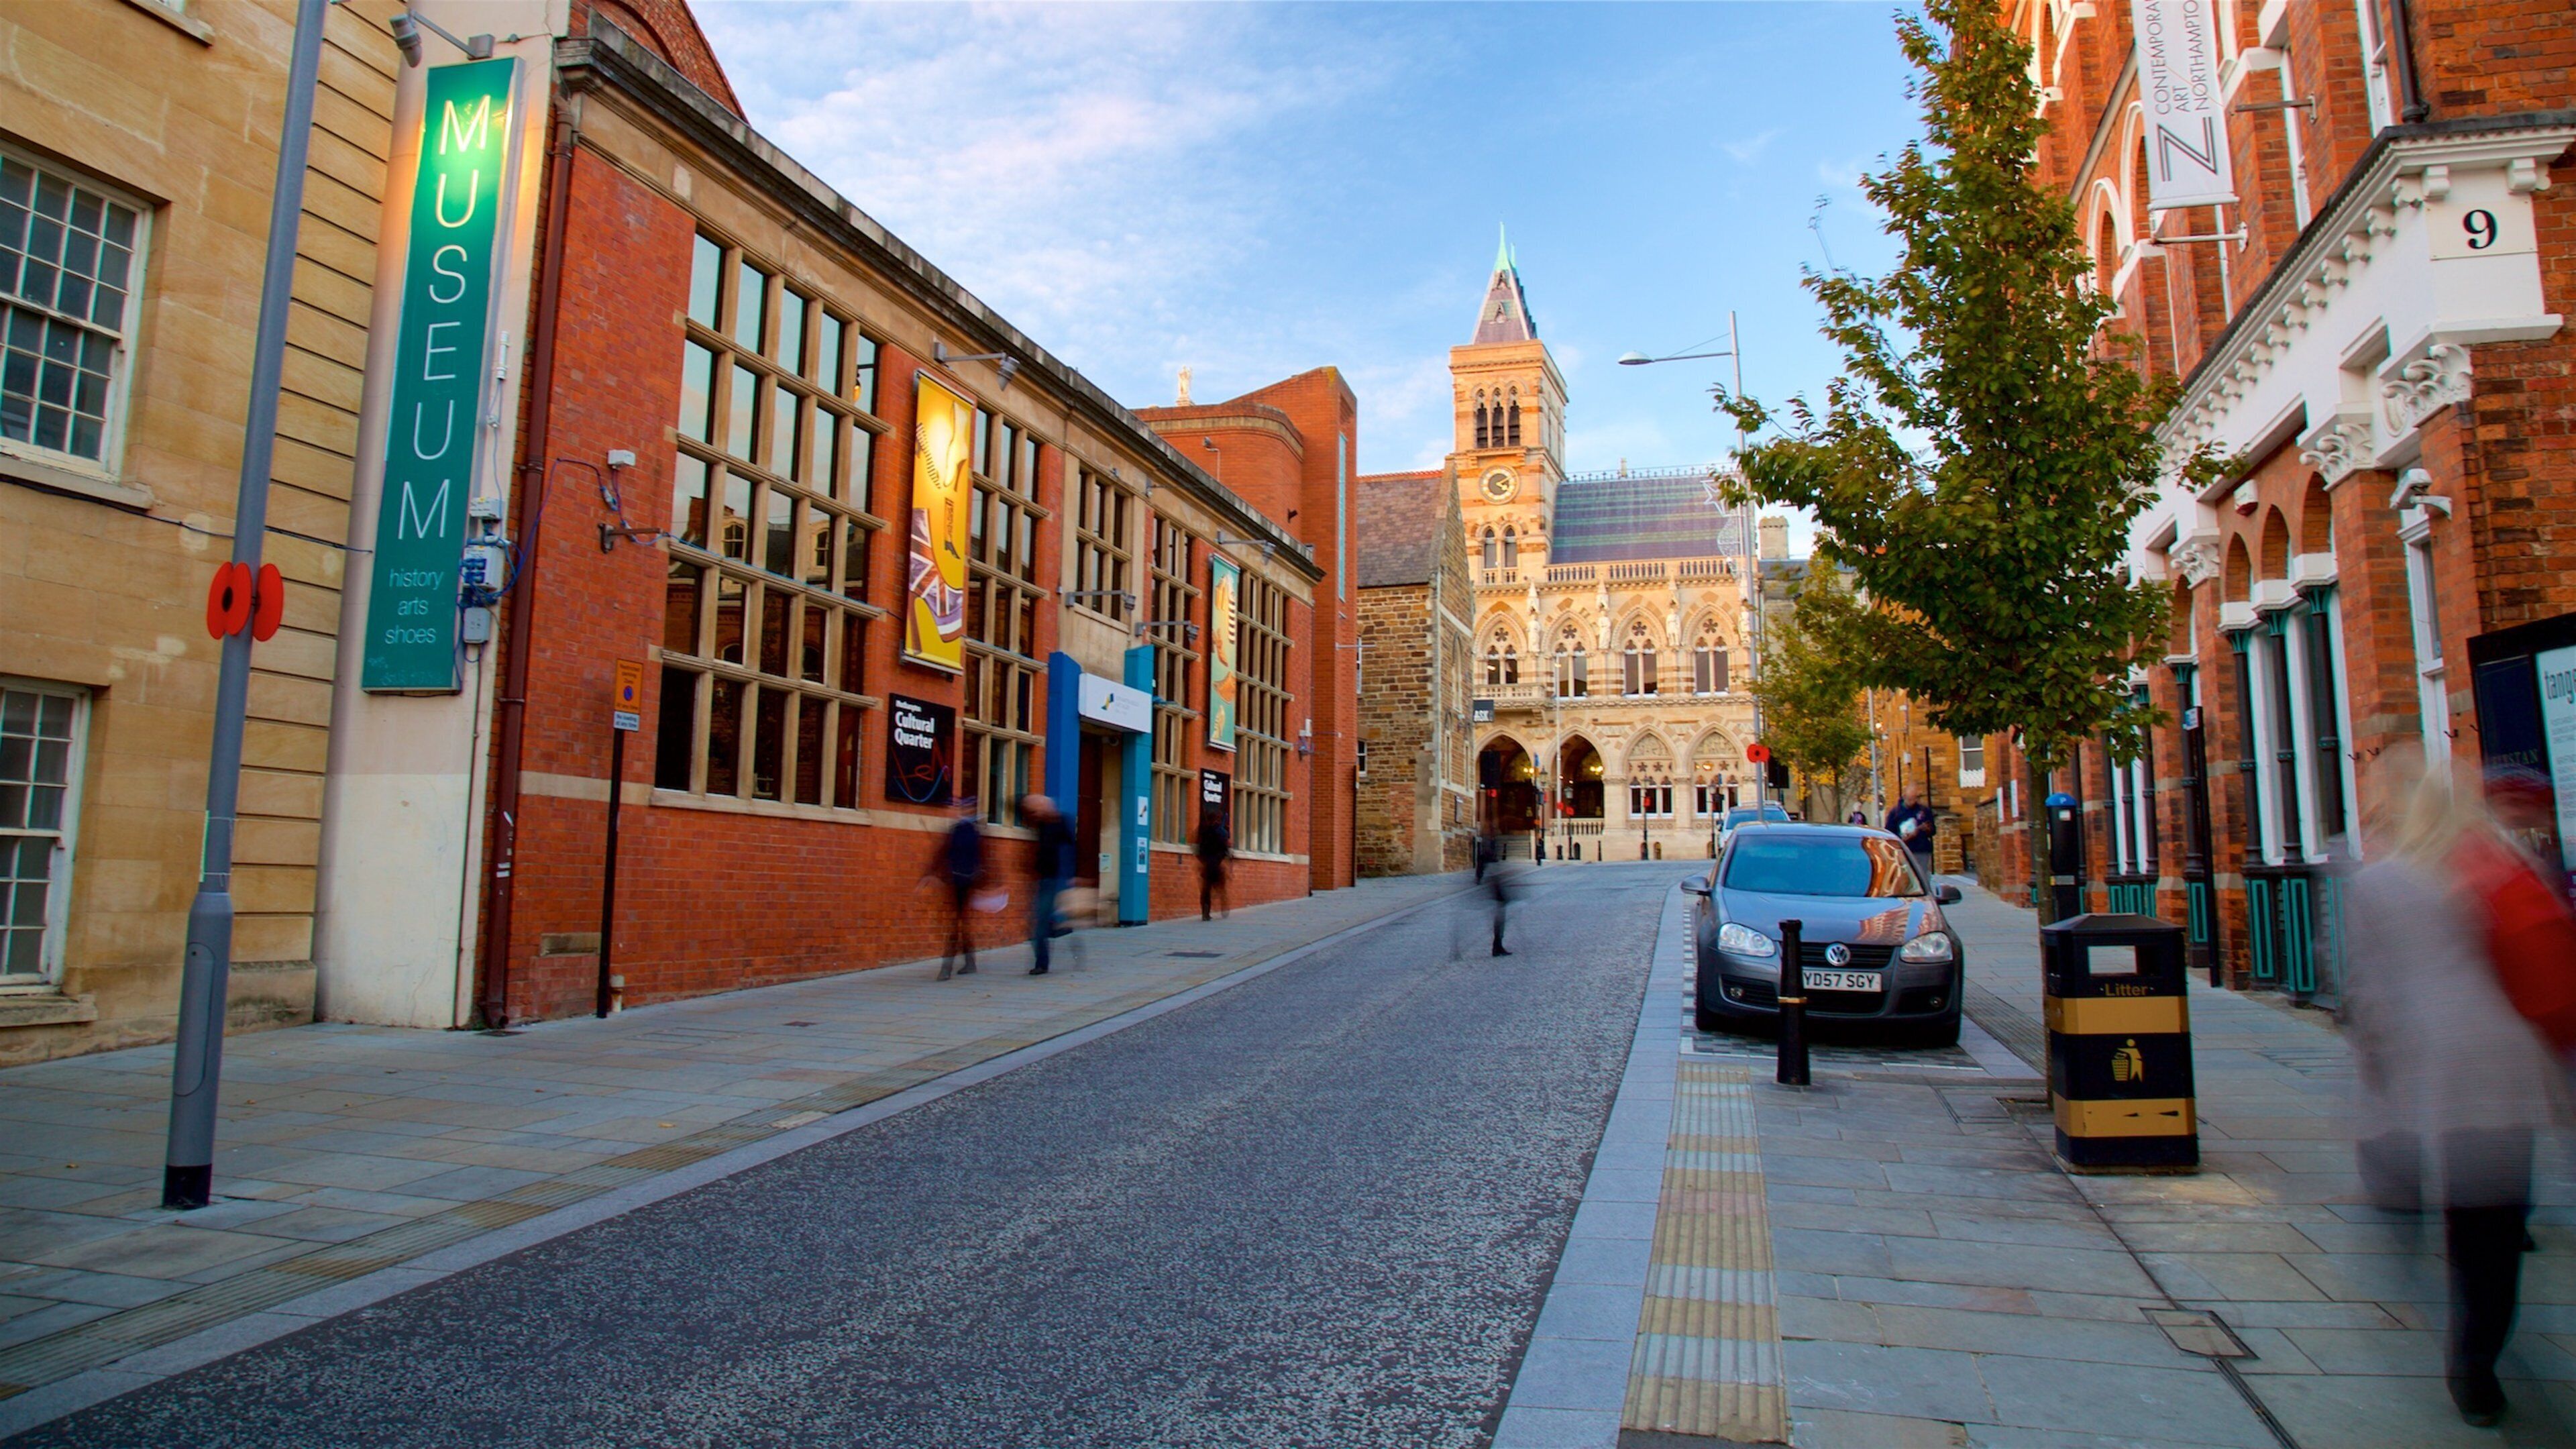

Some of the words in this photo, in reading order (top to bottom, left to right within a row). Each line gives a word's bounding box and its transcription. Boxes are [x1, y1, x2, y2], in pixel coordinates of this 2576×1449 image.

[2172, 86, 2190, 113] ART
[2462, 209, 2497, 250] 9
[398, 94, 491, 540] MUSEUM
[389, 568, 444, 590] history
[397, 596, 429, 615] arts
[384, 625, 437, 644] shoes
[895, 711, 935, 734] Cultural
[894, 728, 933, 750] Quarter
[1803, 973, 1842, 987] YD57
[1846, 975, 1874, 989] SGY
[2104, 983, 2149, 997] Litter
